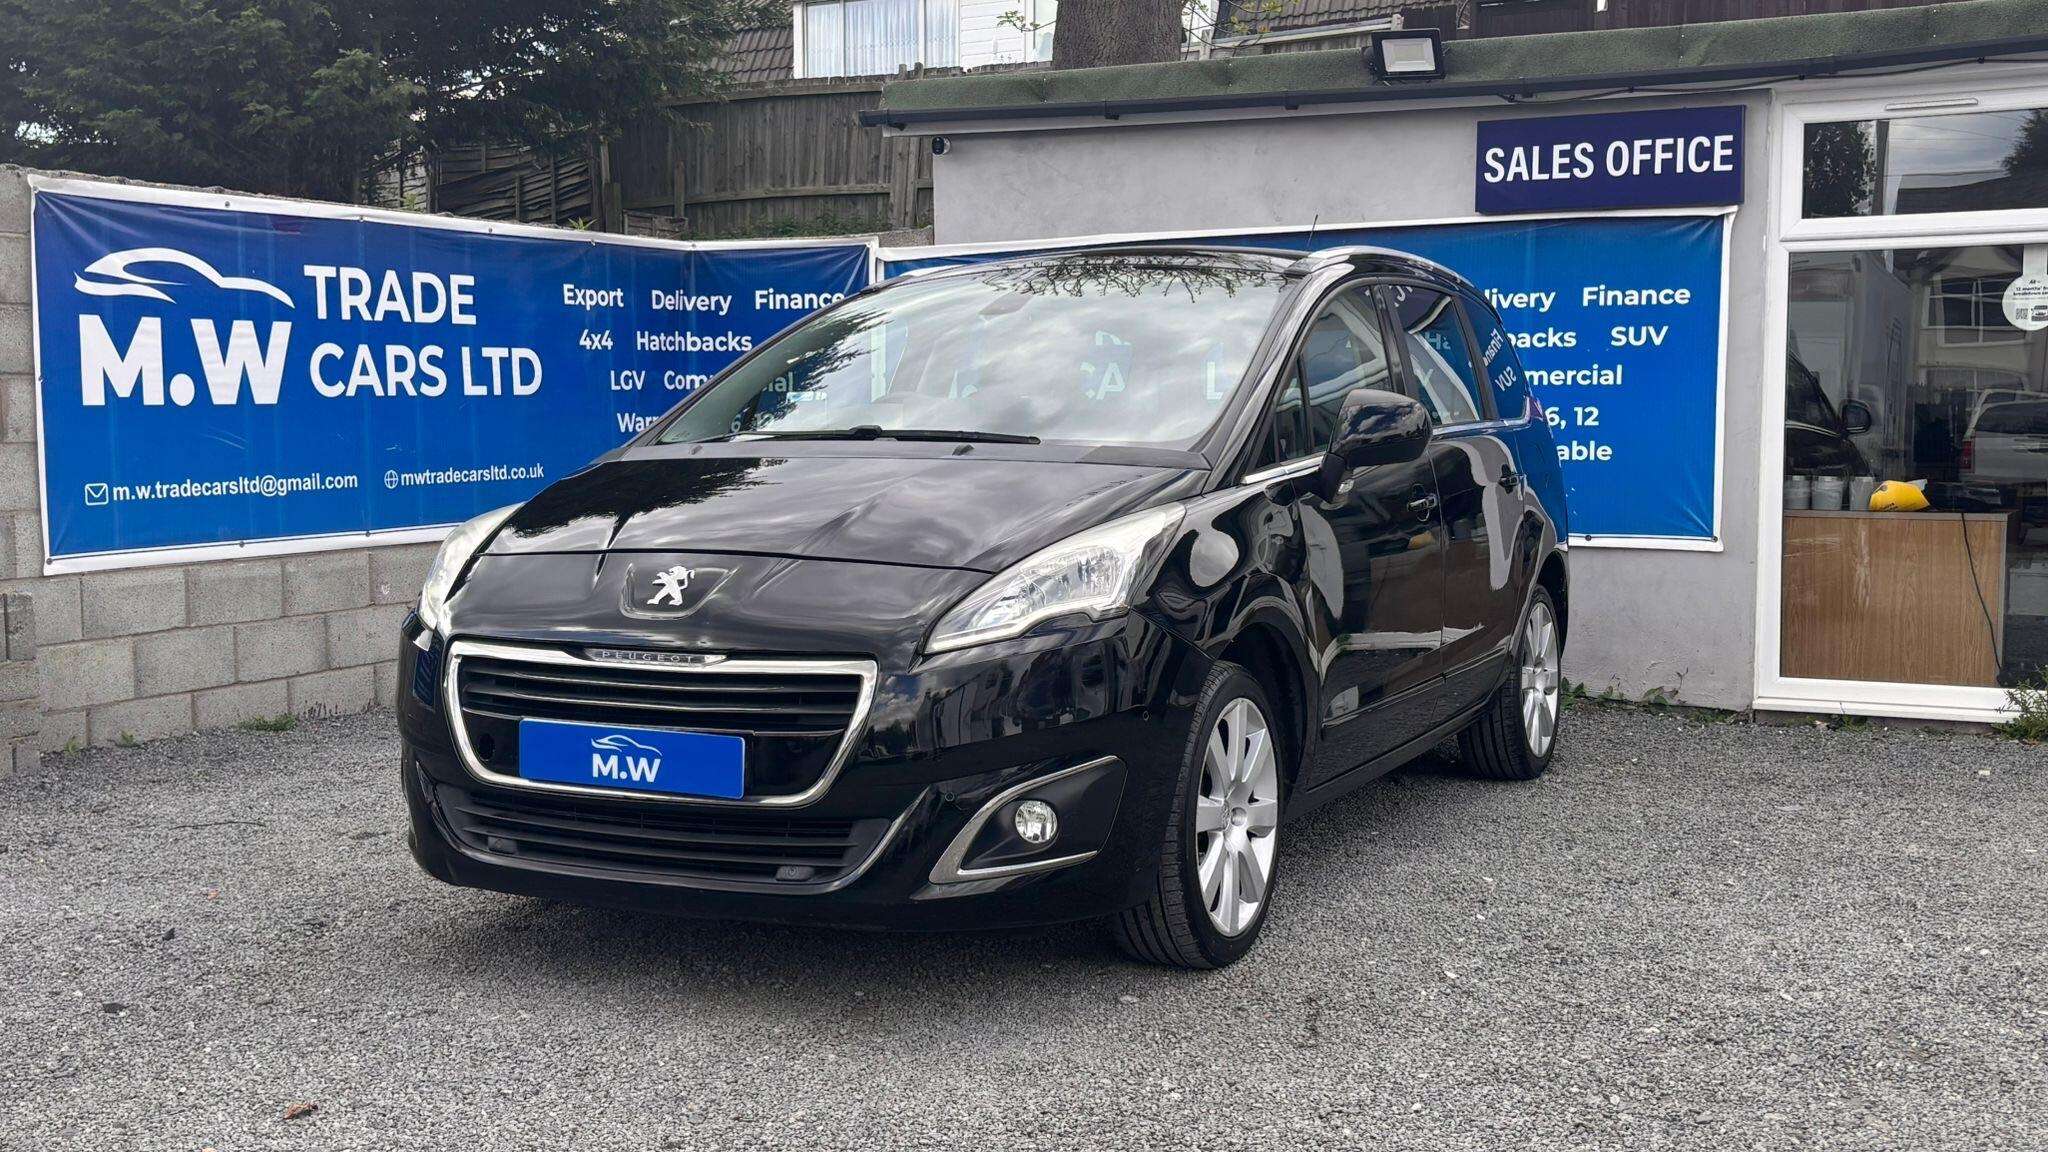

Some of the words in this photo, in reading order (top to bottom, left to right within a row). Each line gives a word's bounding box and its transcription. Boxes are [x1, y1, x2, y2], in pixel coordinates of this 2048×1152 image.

[1484, 143, 1594, 183] SALES
[1606, 135, 1734, 177] OFFICE
[304, 265, 477, 325] TRADE
[563, 284, 624, 308] Export
[651, 290, 732, 316] Delivery
[1583, 284, 1691, 307] Finance
[579, 330, 613, 350] 4x4
[636, 331, 753, 352] Hatchbacks
[1611, 325, 1668, 347] SUV
[78, 314, 292, 406] M.W
[310, 343, 447, 397] CARS
[462, 346, 543, 396] LTD
[610, 370, 646, 391] LGV
[1574, 406, 1600, 426] 12
[112, 474, 358, 501] m.w.tradecarsltd@gmail.com
[401, 463, 544, 487] mwtradecarsltd.co.uk
[602, 650, 694, 663] PEUGEOT
[592, 753, 661, 783] M.W
